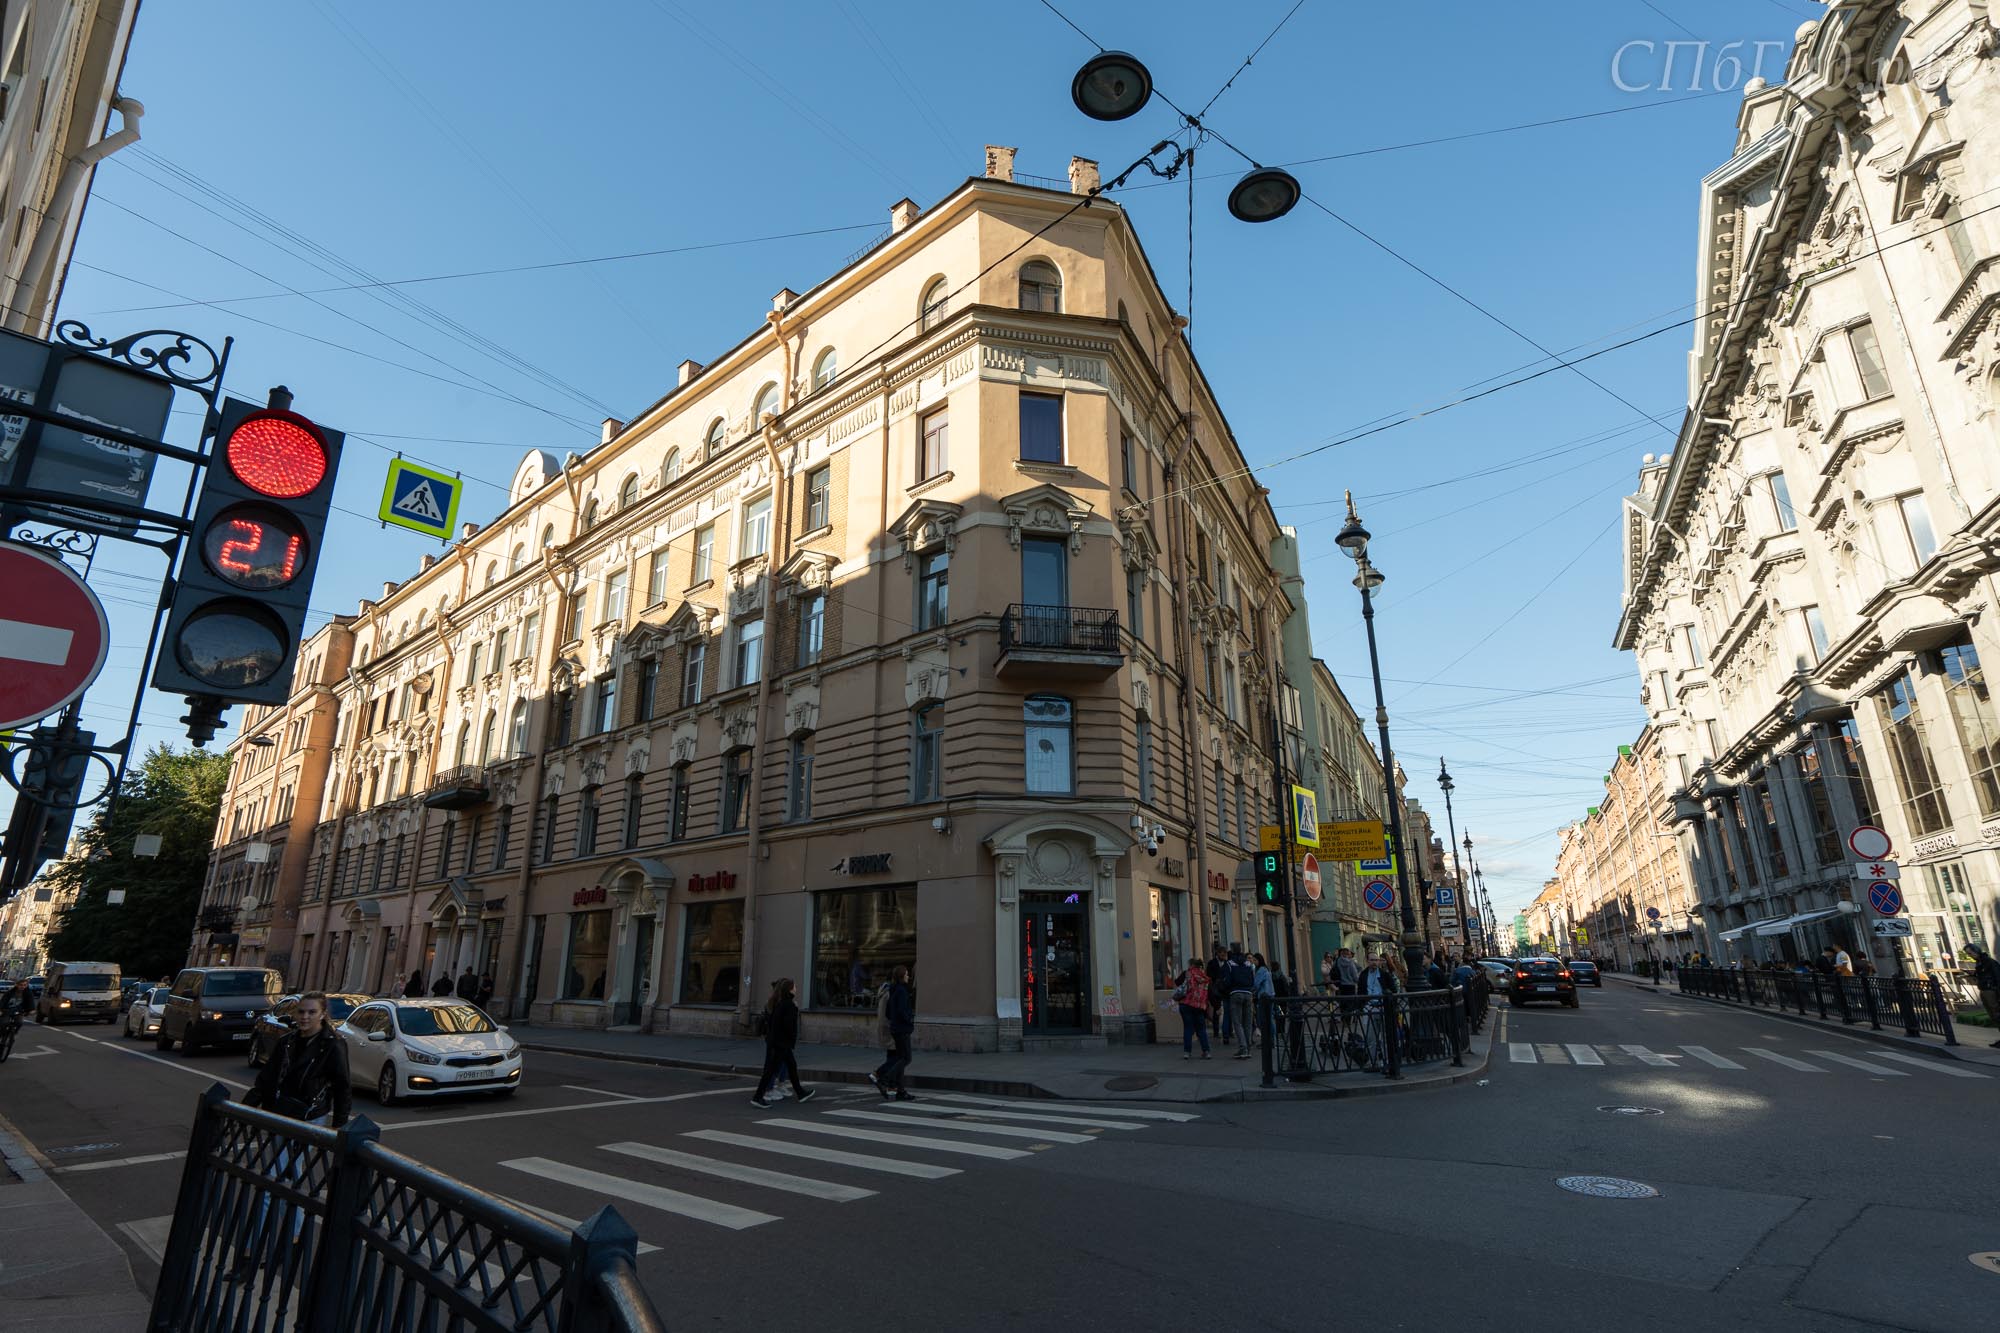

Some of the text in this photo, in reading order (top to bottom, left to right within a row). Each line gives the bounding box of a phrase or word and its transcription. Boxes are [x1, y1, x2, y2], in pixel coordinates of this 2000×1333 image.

[221, 520, 300, 580] 21
[849, 853, 892, 874] FRANK
[1264, 856, 1276, 872] 13
